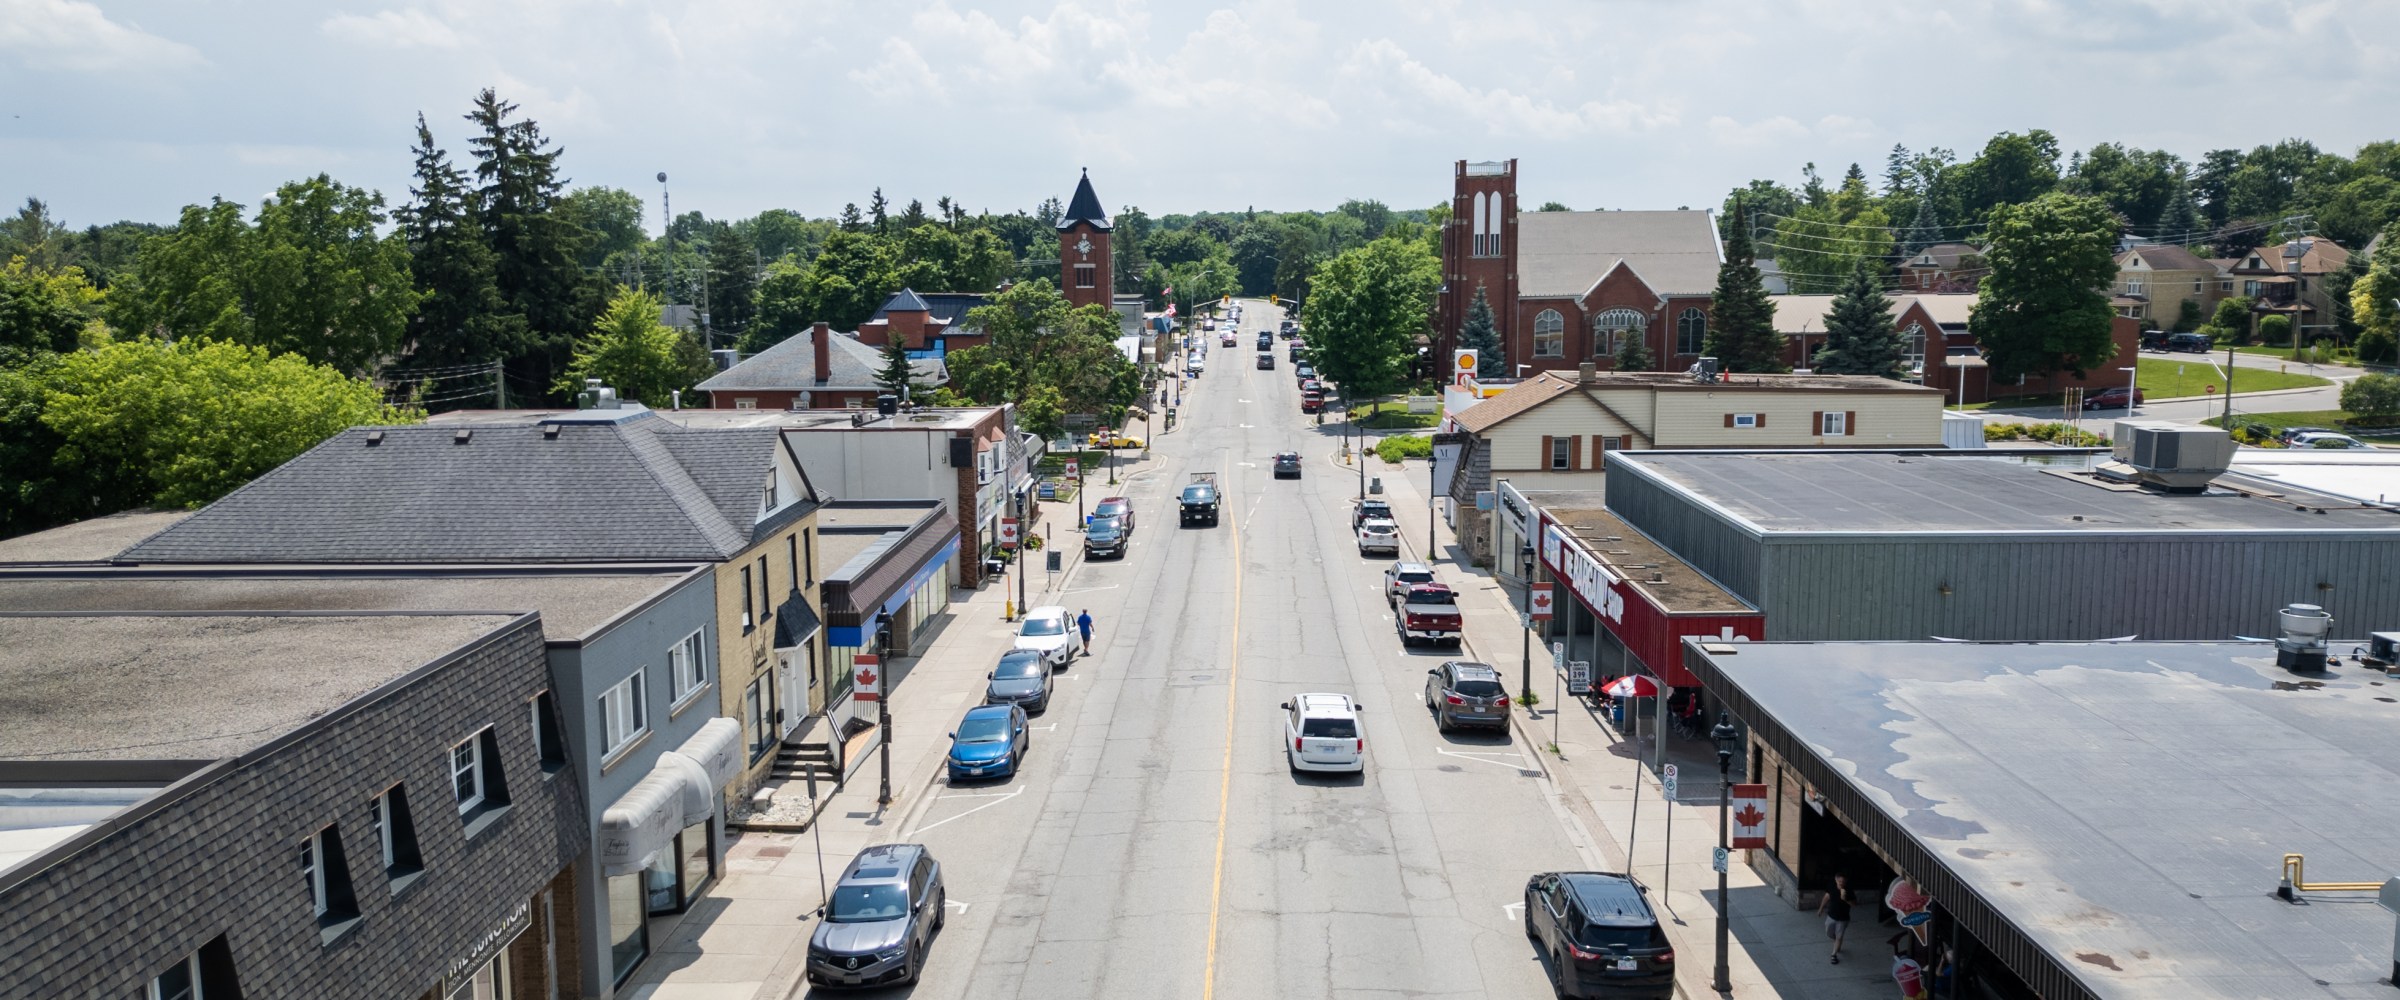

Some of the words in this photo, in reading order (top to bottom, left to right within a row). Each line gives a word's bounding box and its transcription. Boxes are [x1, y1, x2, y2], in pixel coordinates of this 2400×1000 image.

[1563, 547, 1574, 580] THE
[1607, 586, 1624, 625] SHOP
[447, 973, 462, 991] ZION
[463, 944, 494, 976] MENNONITE
[496, 916, 526, 947] FELLOWSHIP
